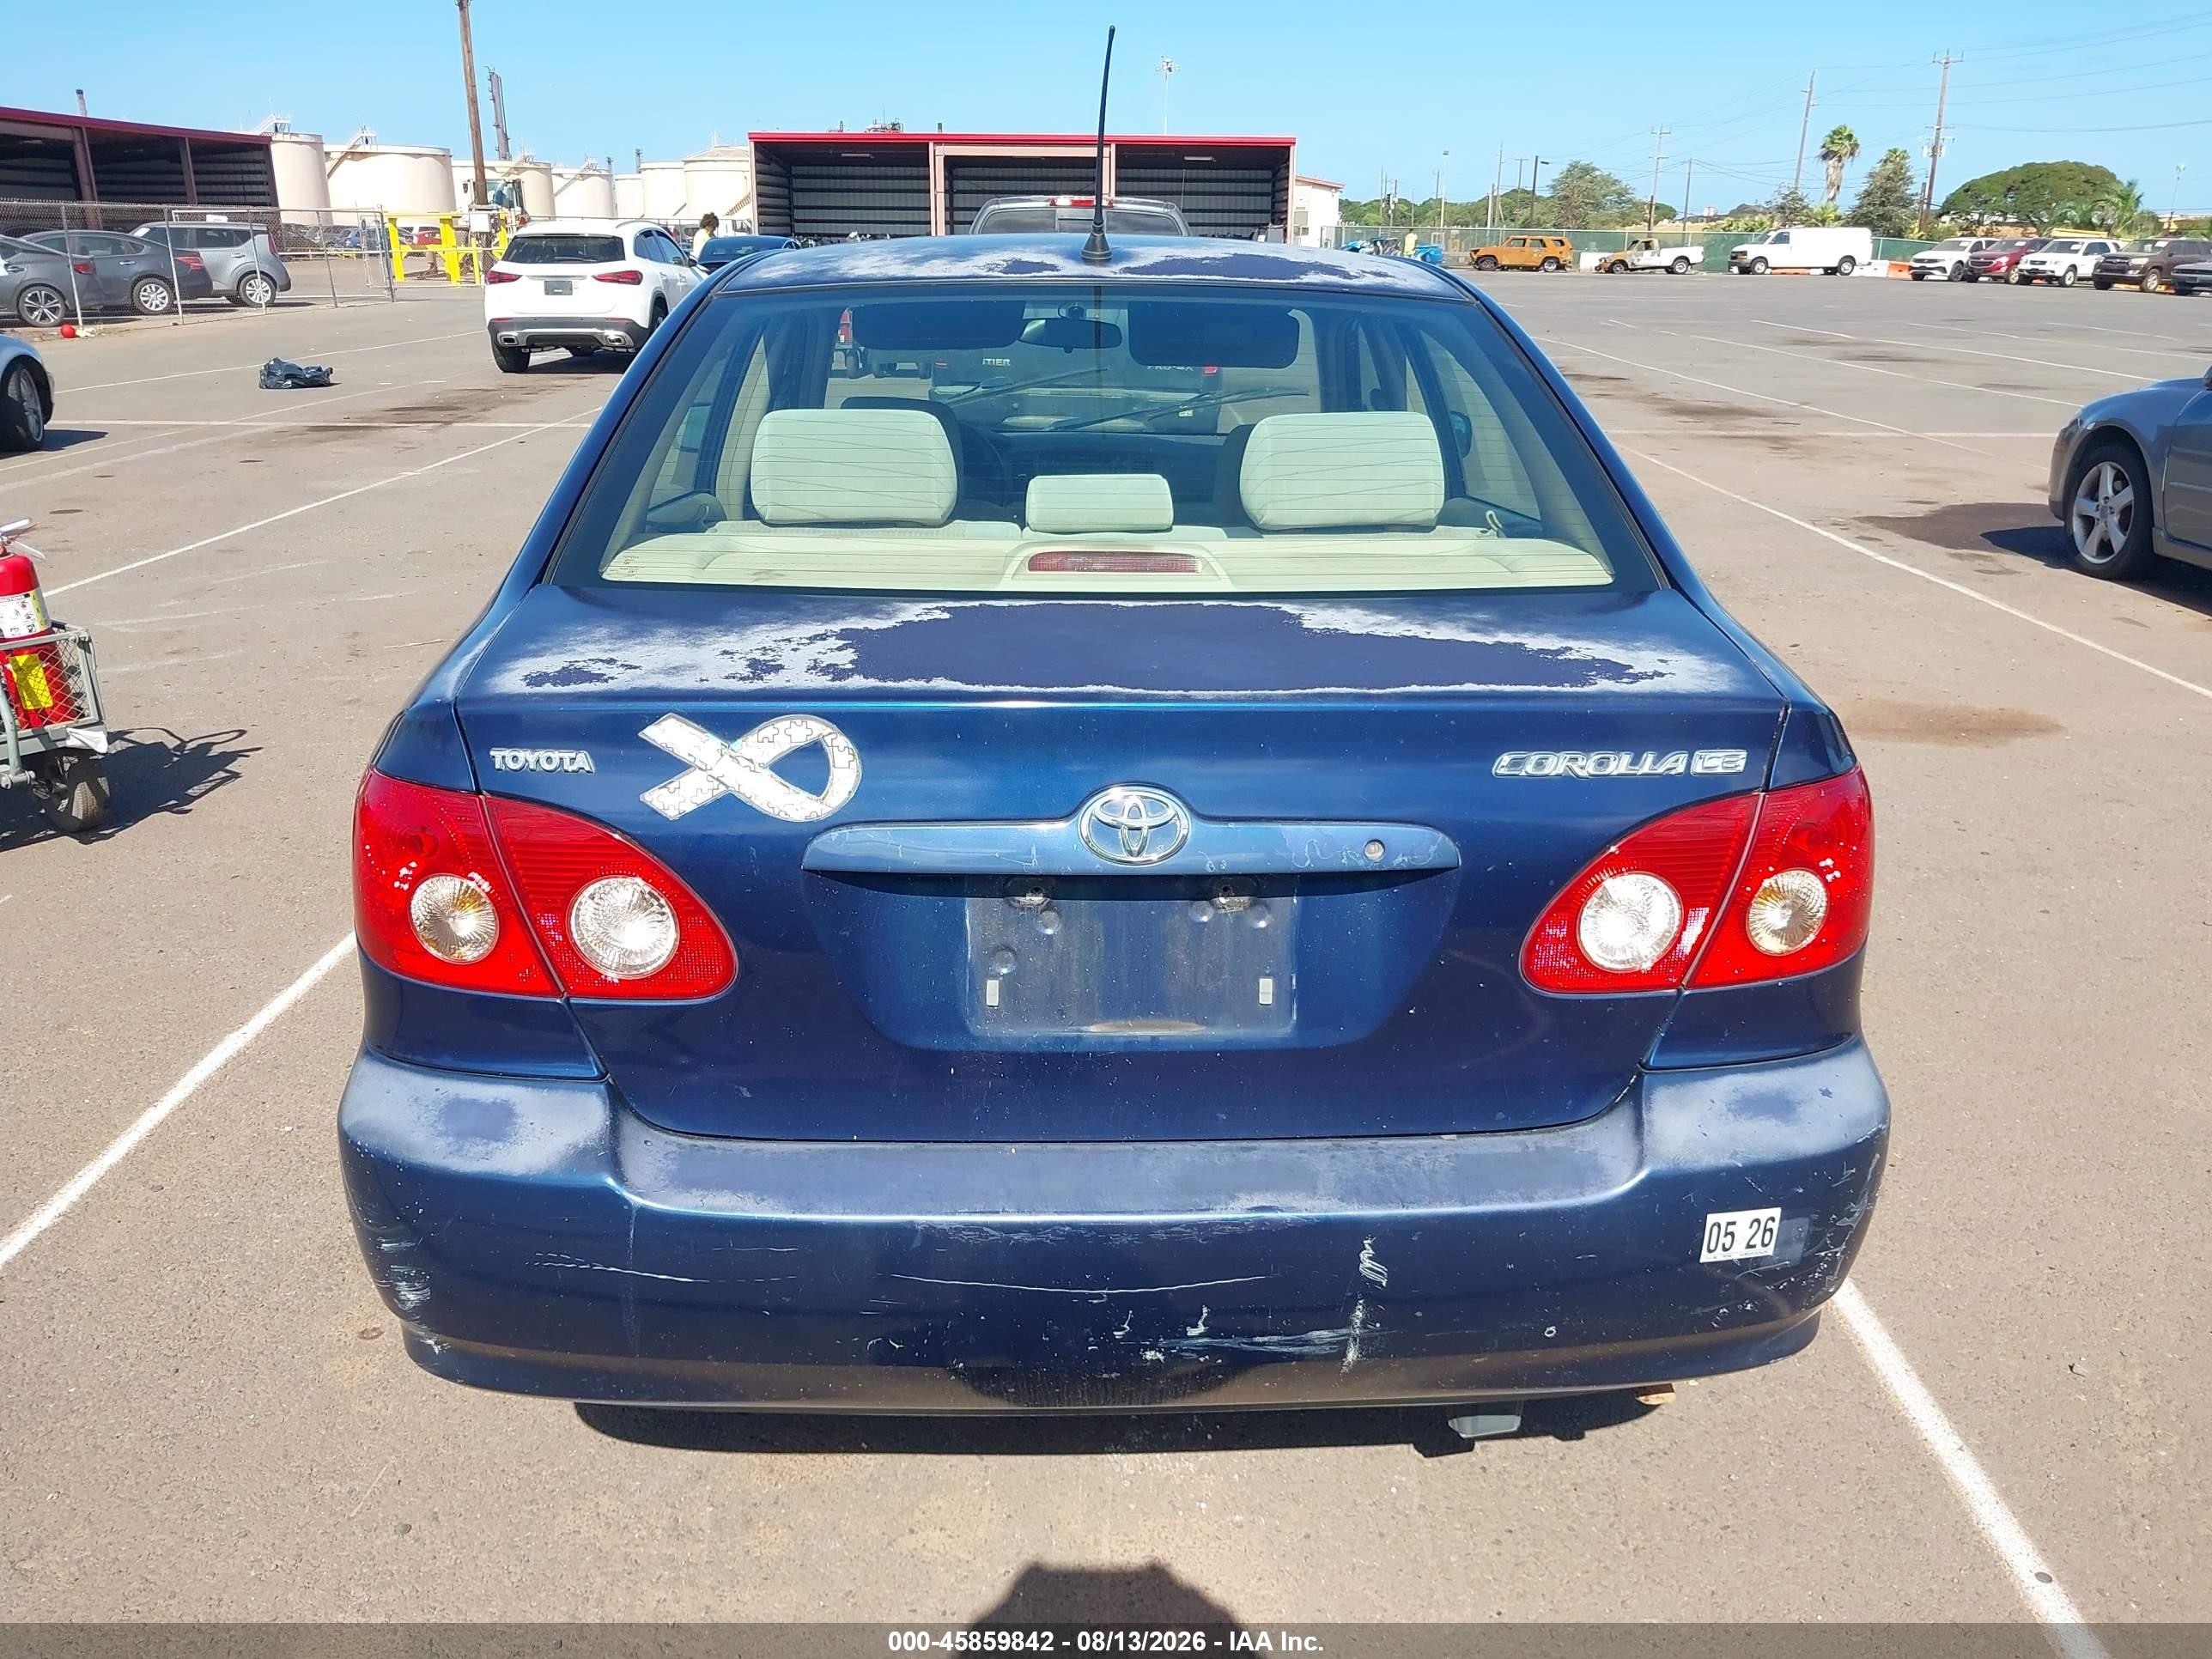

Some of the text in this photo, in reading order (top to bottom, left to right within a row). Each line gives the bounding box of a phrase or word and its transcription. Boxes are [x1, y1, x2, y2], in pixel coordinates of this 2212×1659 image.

[489, 748, 594, 774] TOYOTA
[1492, 750, 1689, 778] COROLLA
[1706, 1216, 1776, 1254] 05 26
